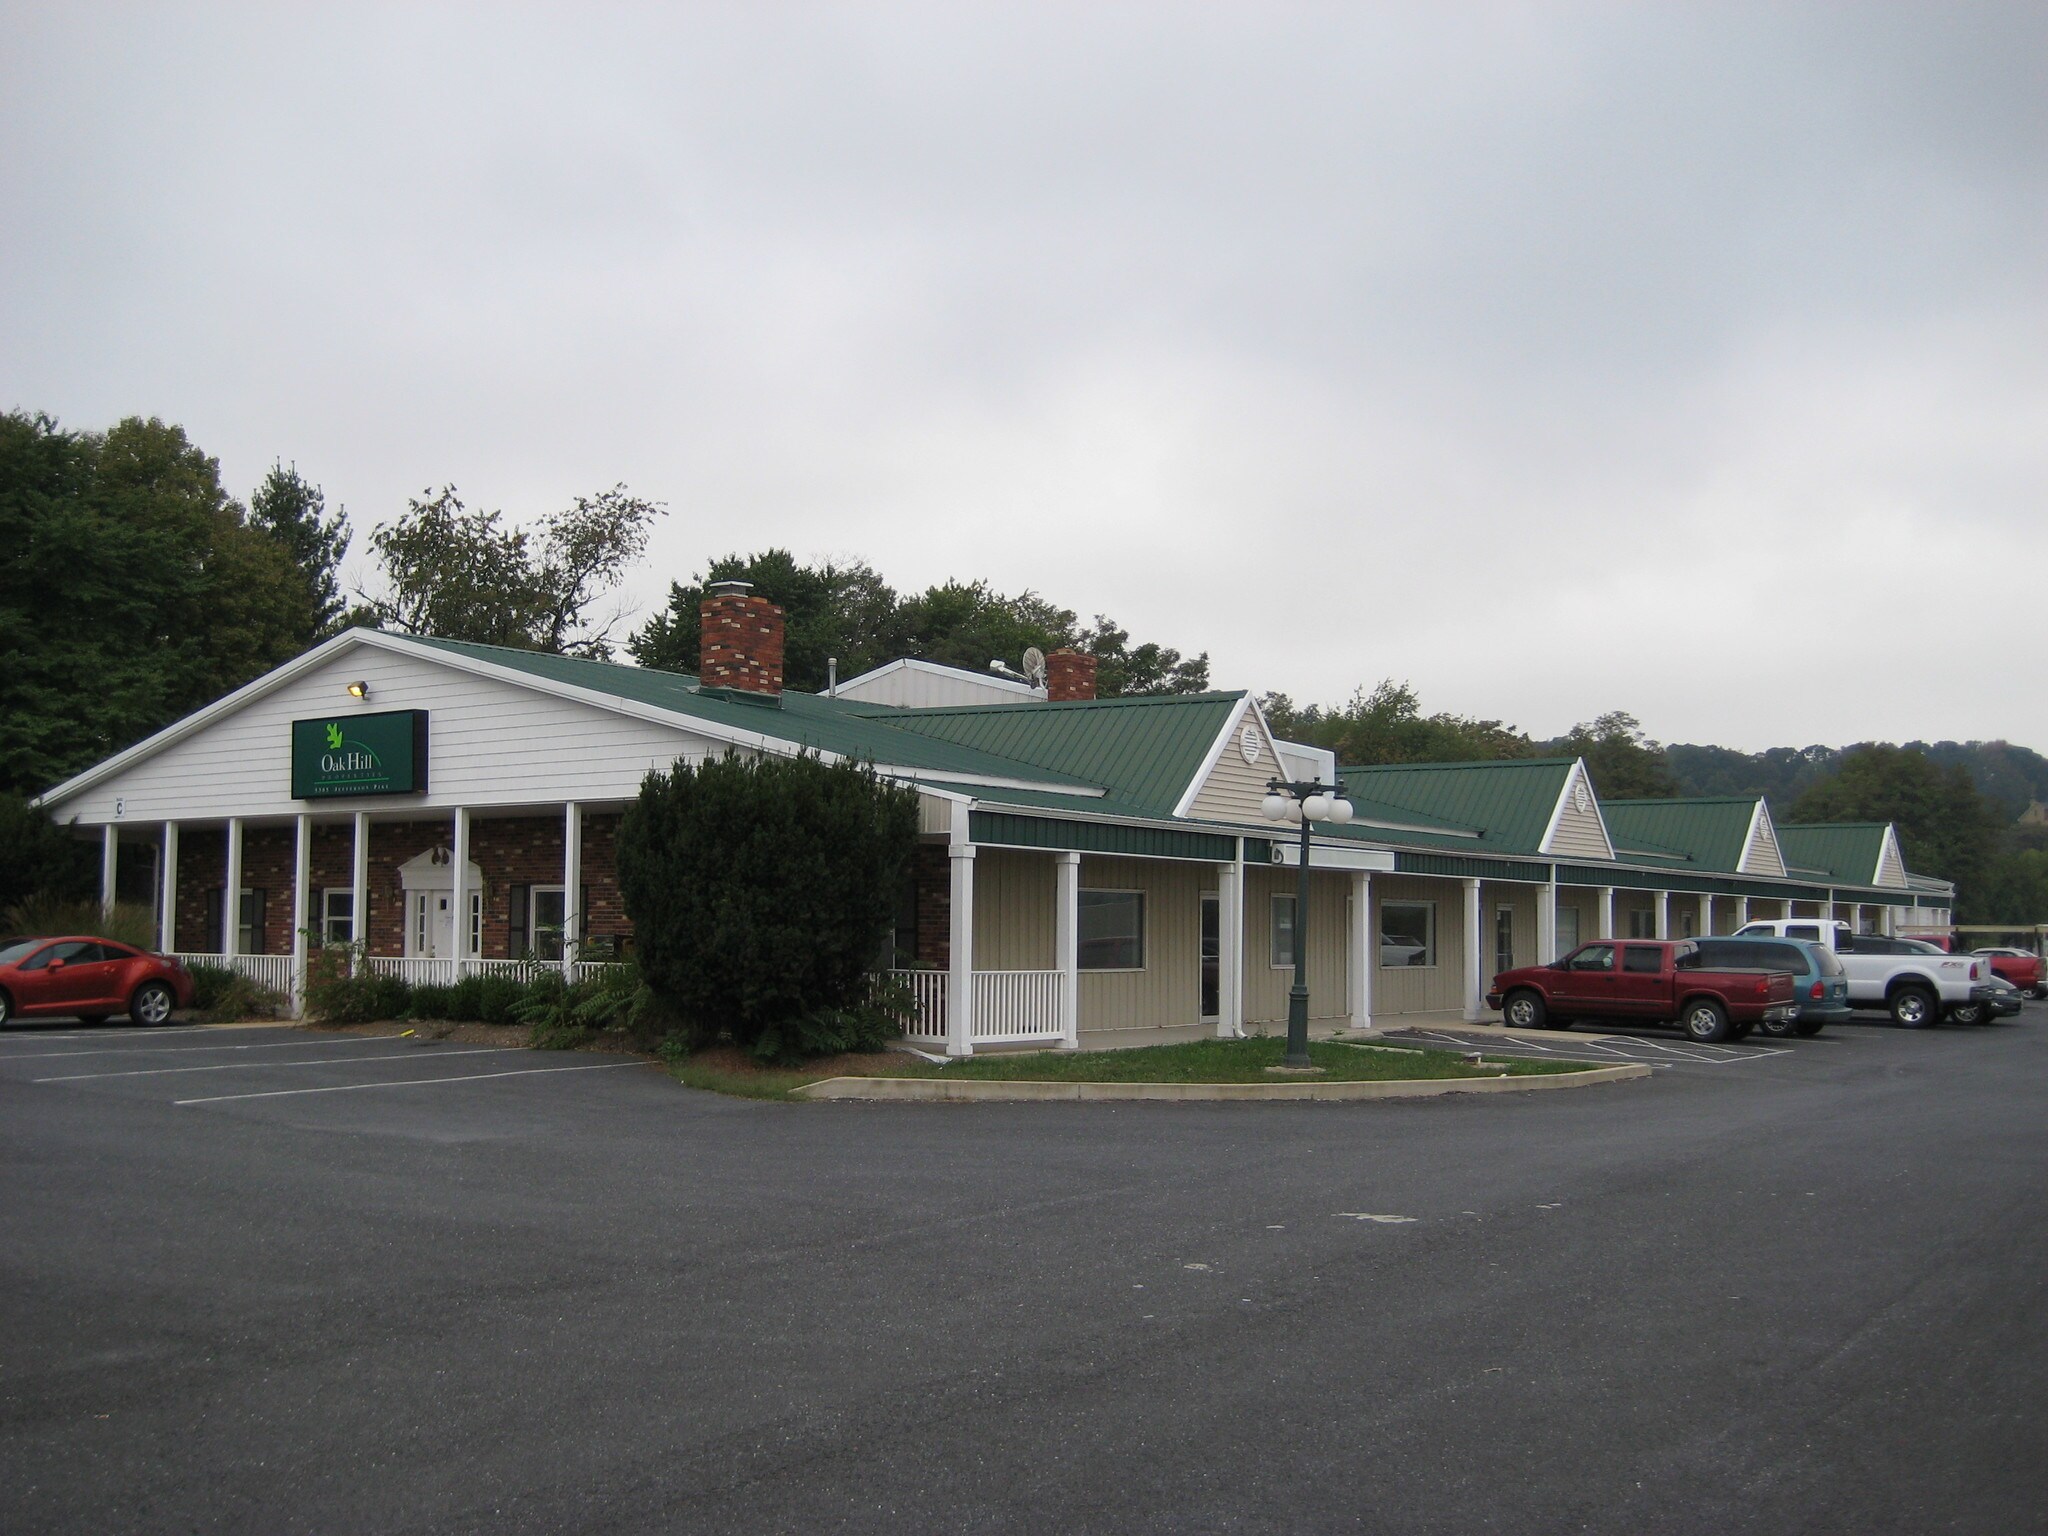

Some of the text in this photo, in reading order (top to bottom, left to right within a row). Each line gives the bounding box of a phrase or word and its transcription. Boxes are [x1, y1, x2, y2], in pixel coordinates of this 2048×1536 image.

[321, 752, 372, 772] Oak Hill
[117, 802, 123, 815] C
